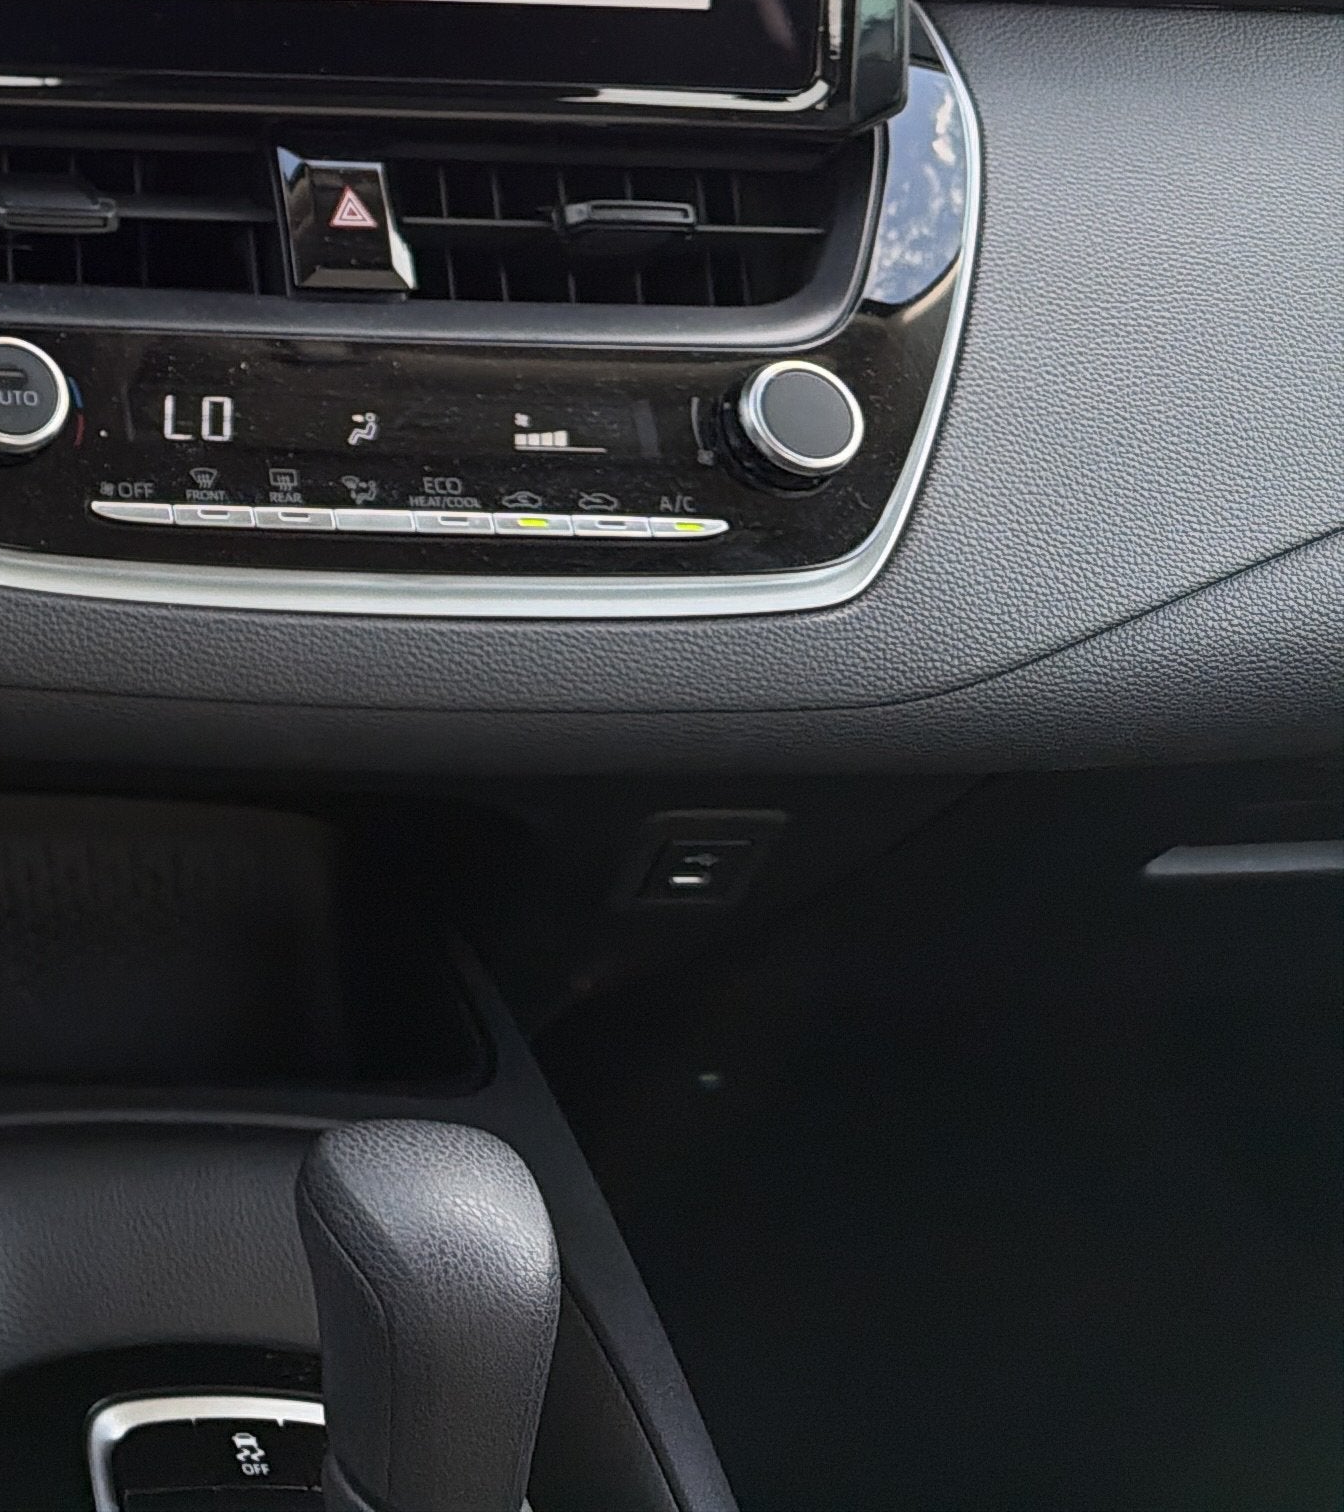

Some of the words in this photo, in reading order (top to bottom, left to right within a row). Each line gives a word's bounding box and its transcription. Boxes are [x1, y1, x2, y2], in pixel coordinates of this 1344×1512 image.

[164, 394, 234, 442] LO
[118, 482, 156, 498] OFF
[422, 476, 462, 494] ECO
[185, 489, 226, 501] FRONT
[269, 491, 303, 503] REAR
[408, 494, 481, 509] HEAT/COOL
[659, 495, 697, 513] A/C
[242, 1462, 270, 1477] OFF
